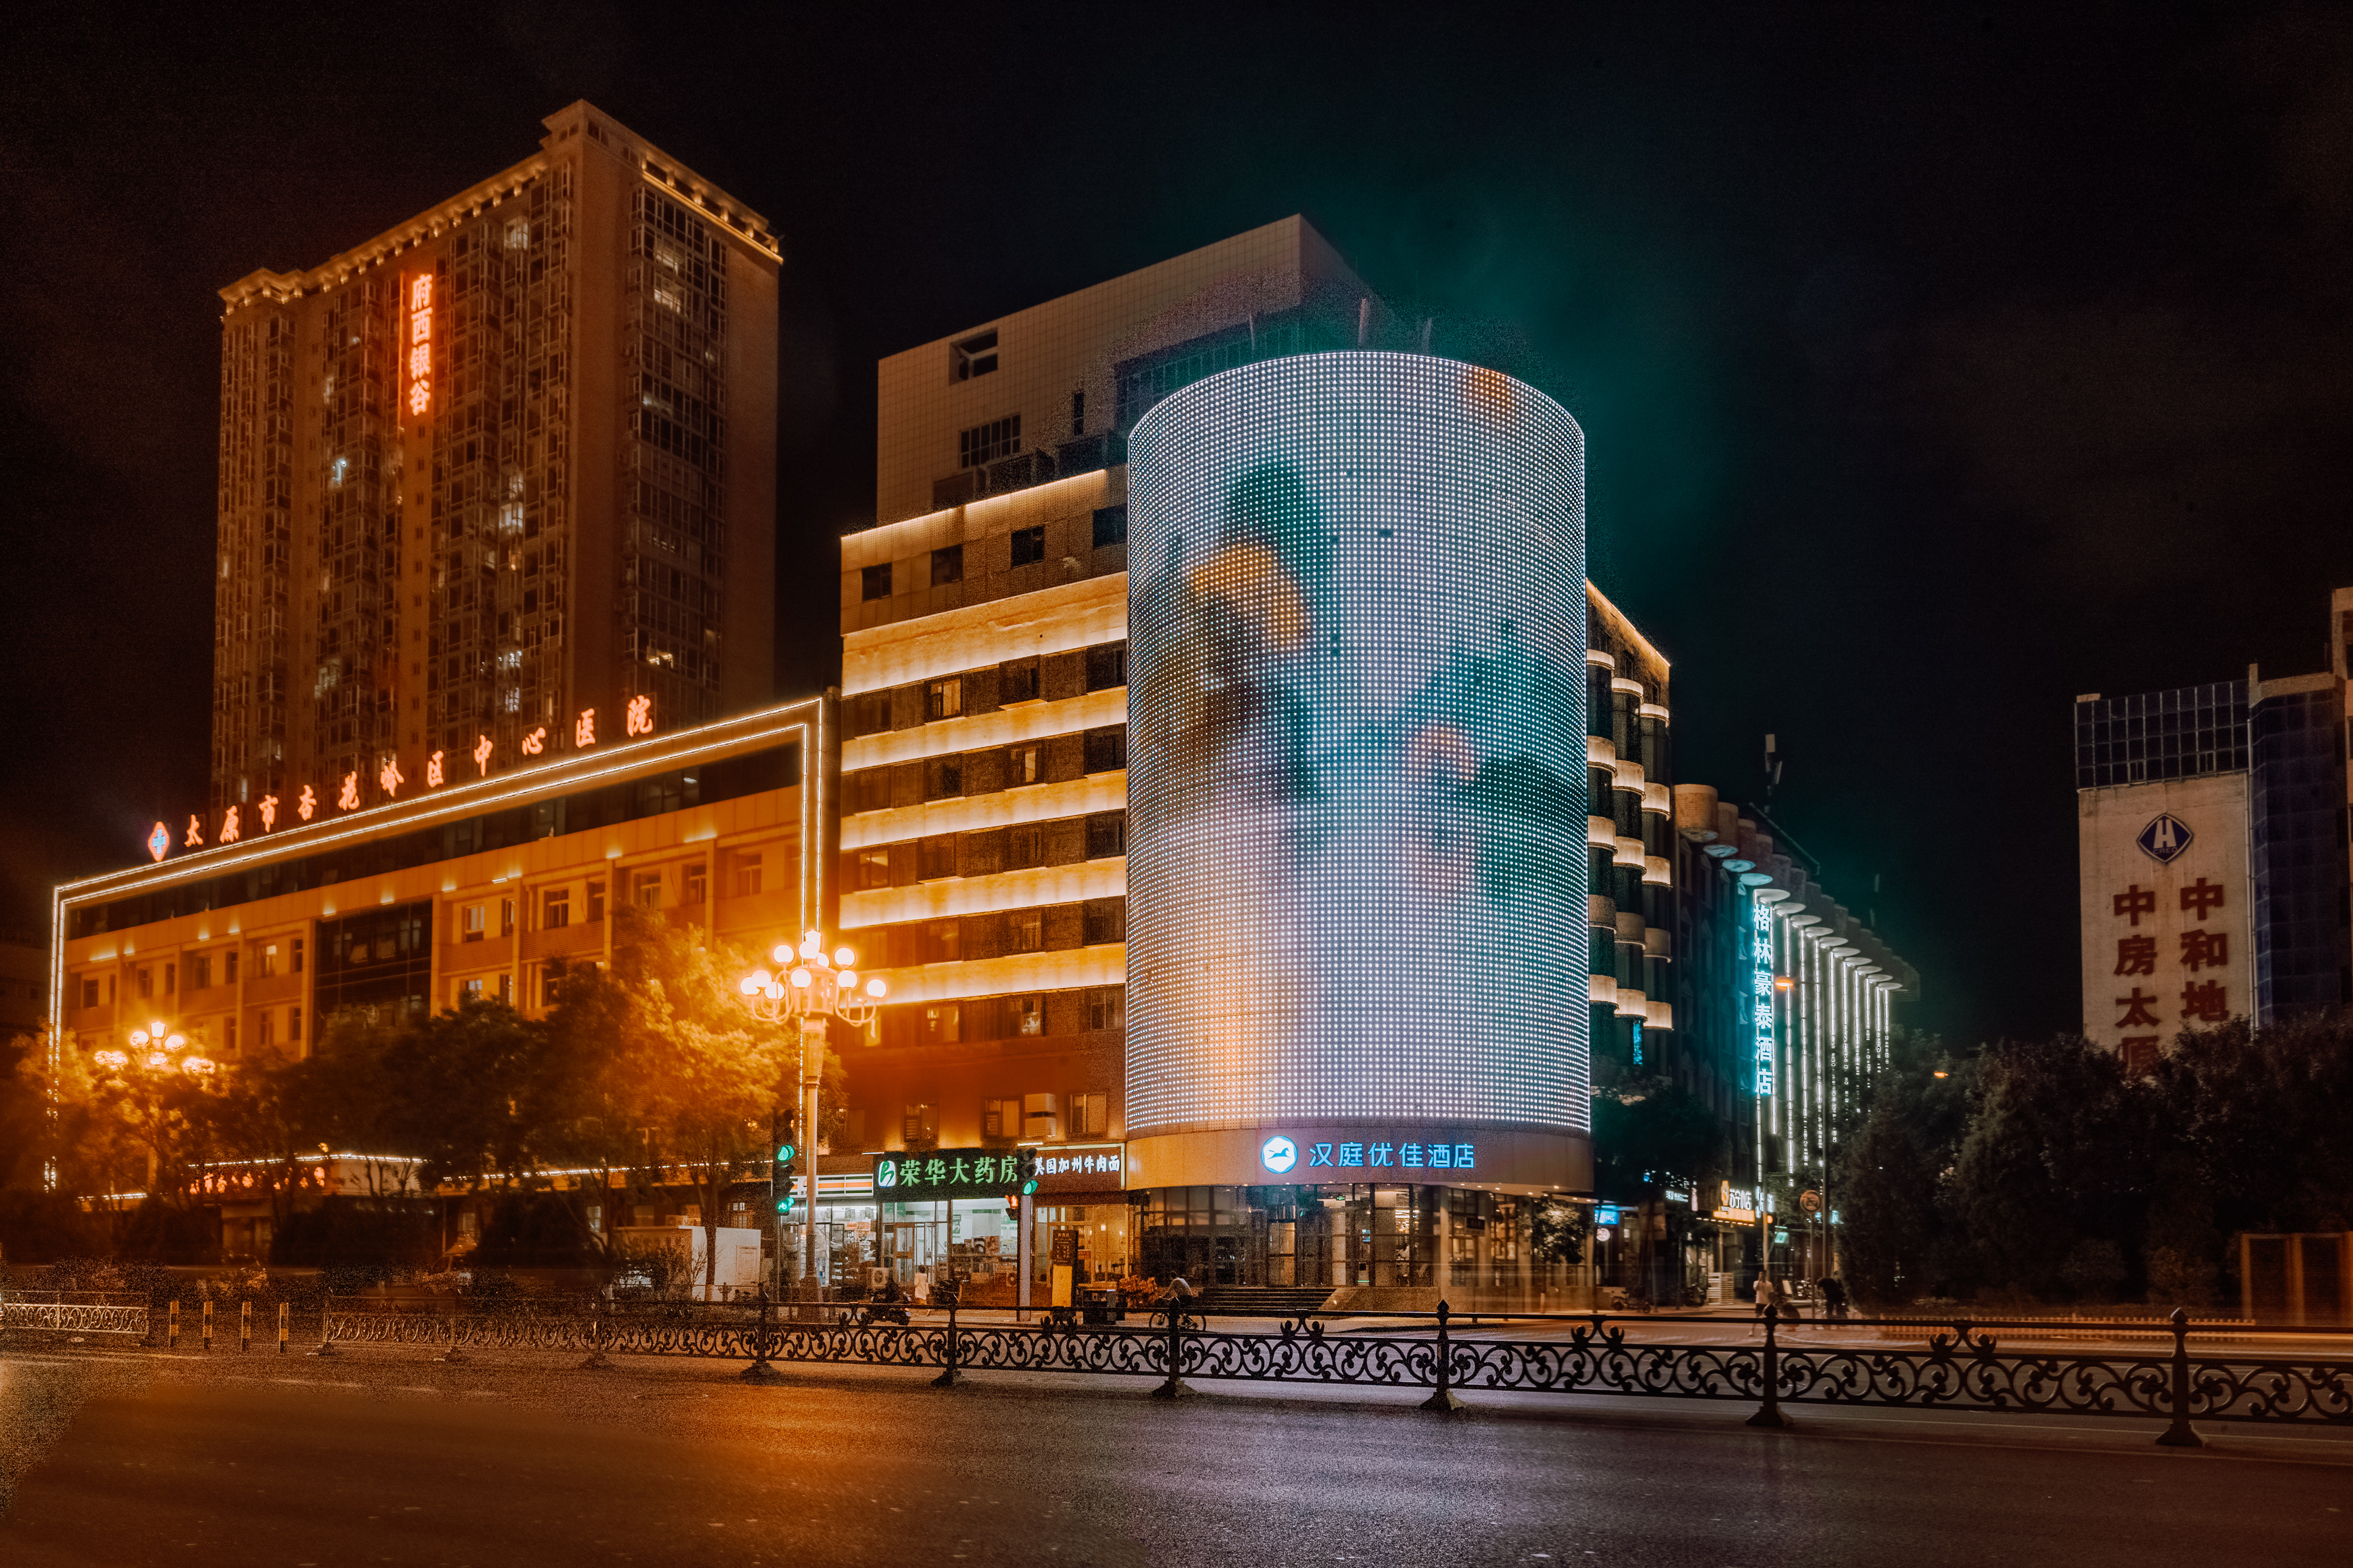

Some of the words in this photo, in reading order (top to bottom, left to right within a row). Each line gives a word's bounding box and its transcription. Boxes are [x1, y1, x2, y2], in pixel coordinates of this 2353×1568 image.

[410, 273, 432, 416] 府西银谷
[184, 695, 653, 847] 太原市杏花岭区中心医院
[1753, 904, 1773, 1096] 格林豪泰酒店
[900, 1155, 1018, 1187] 荣华大药房
[1034, 1155, 1120, 1176] 美国加州牛肉面
[1309, 1142, 1475, 1169] 汉庭优佳酒店
